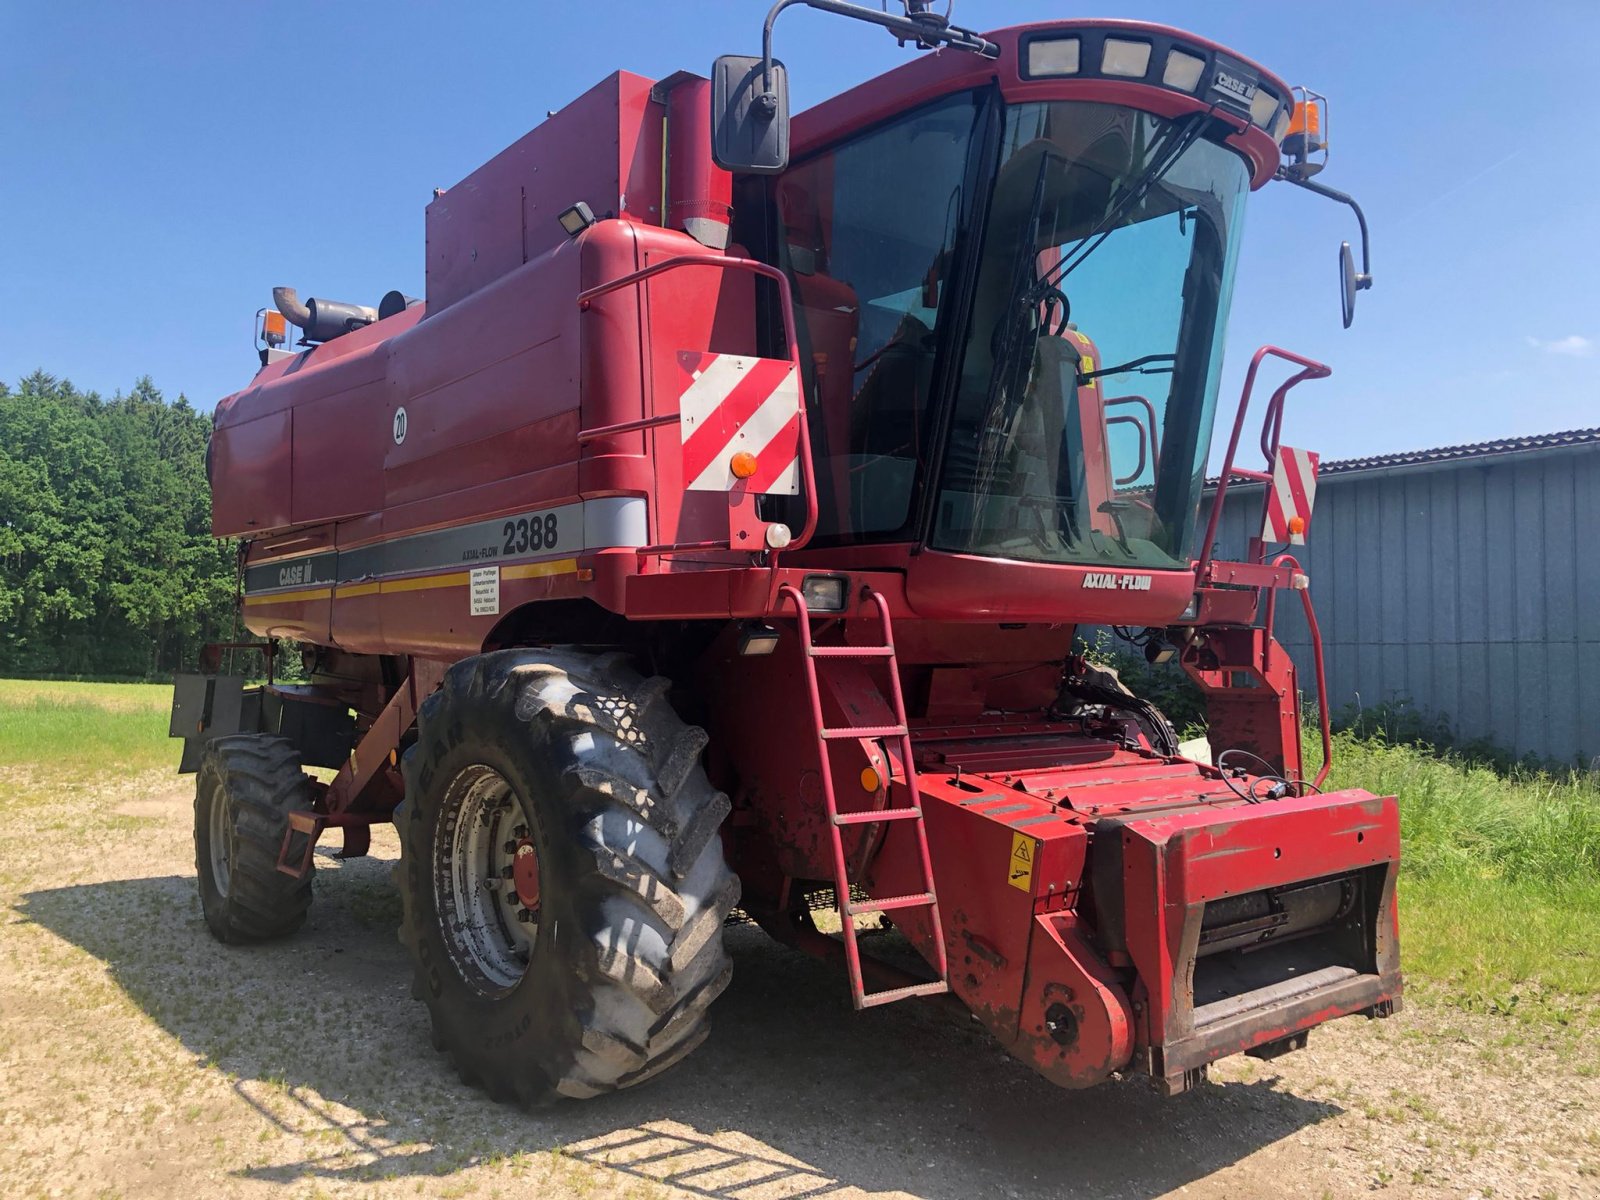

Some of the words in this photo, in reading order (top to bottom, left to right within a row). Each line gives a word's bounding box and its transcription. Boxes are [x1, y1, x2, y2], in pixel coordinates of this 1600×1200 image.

[1218, 72, 1246, 95] CASE
[396, 413, 404, 439] 20
[462, 546, 498, 560] AXIAL-FLOW
[503, 513, 558, 555] 2388
[280, 566, 303, 586] CASE
[1082, 573, 1152, 590] AXIAL-FLOW
